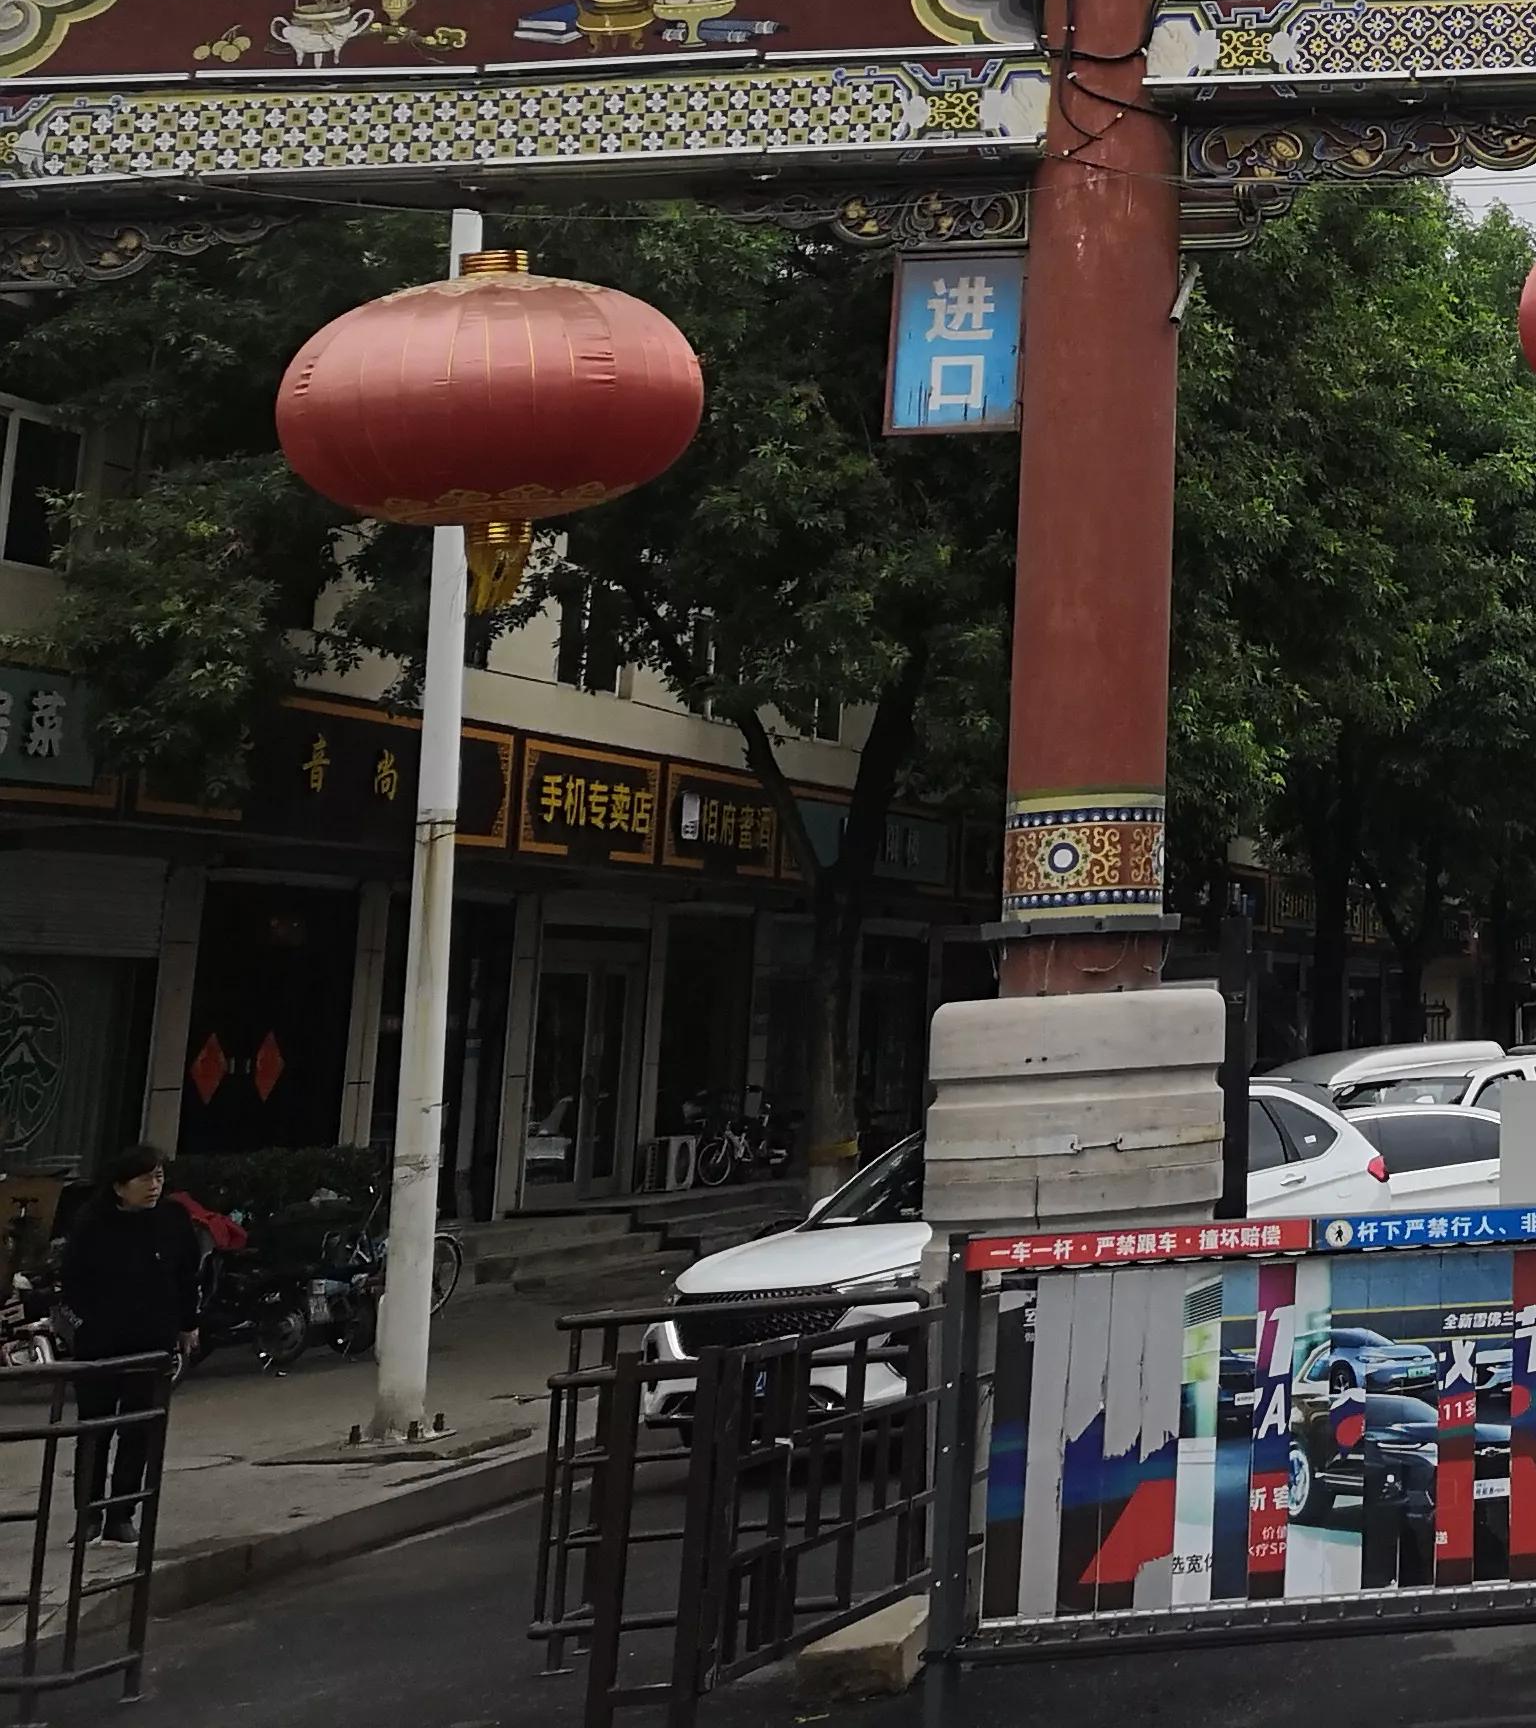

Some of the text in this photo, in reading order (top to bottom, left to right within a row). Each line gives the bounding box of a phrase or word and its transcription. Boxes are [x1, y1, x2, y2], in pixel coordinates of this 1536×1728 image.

[925, 276, 994, 410] 进口
[541, 774, 653, 834] 手机专卖店
